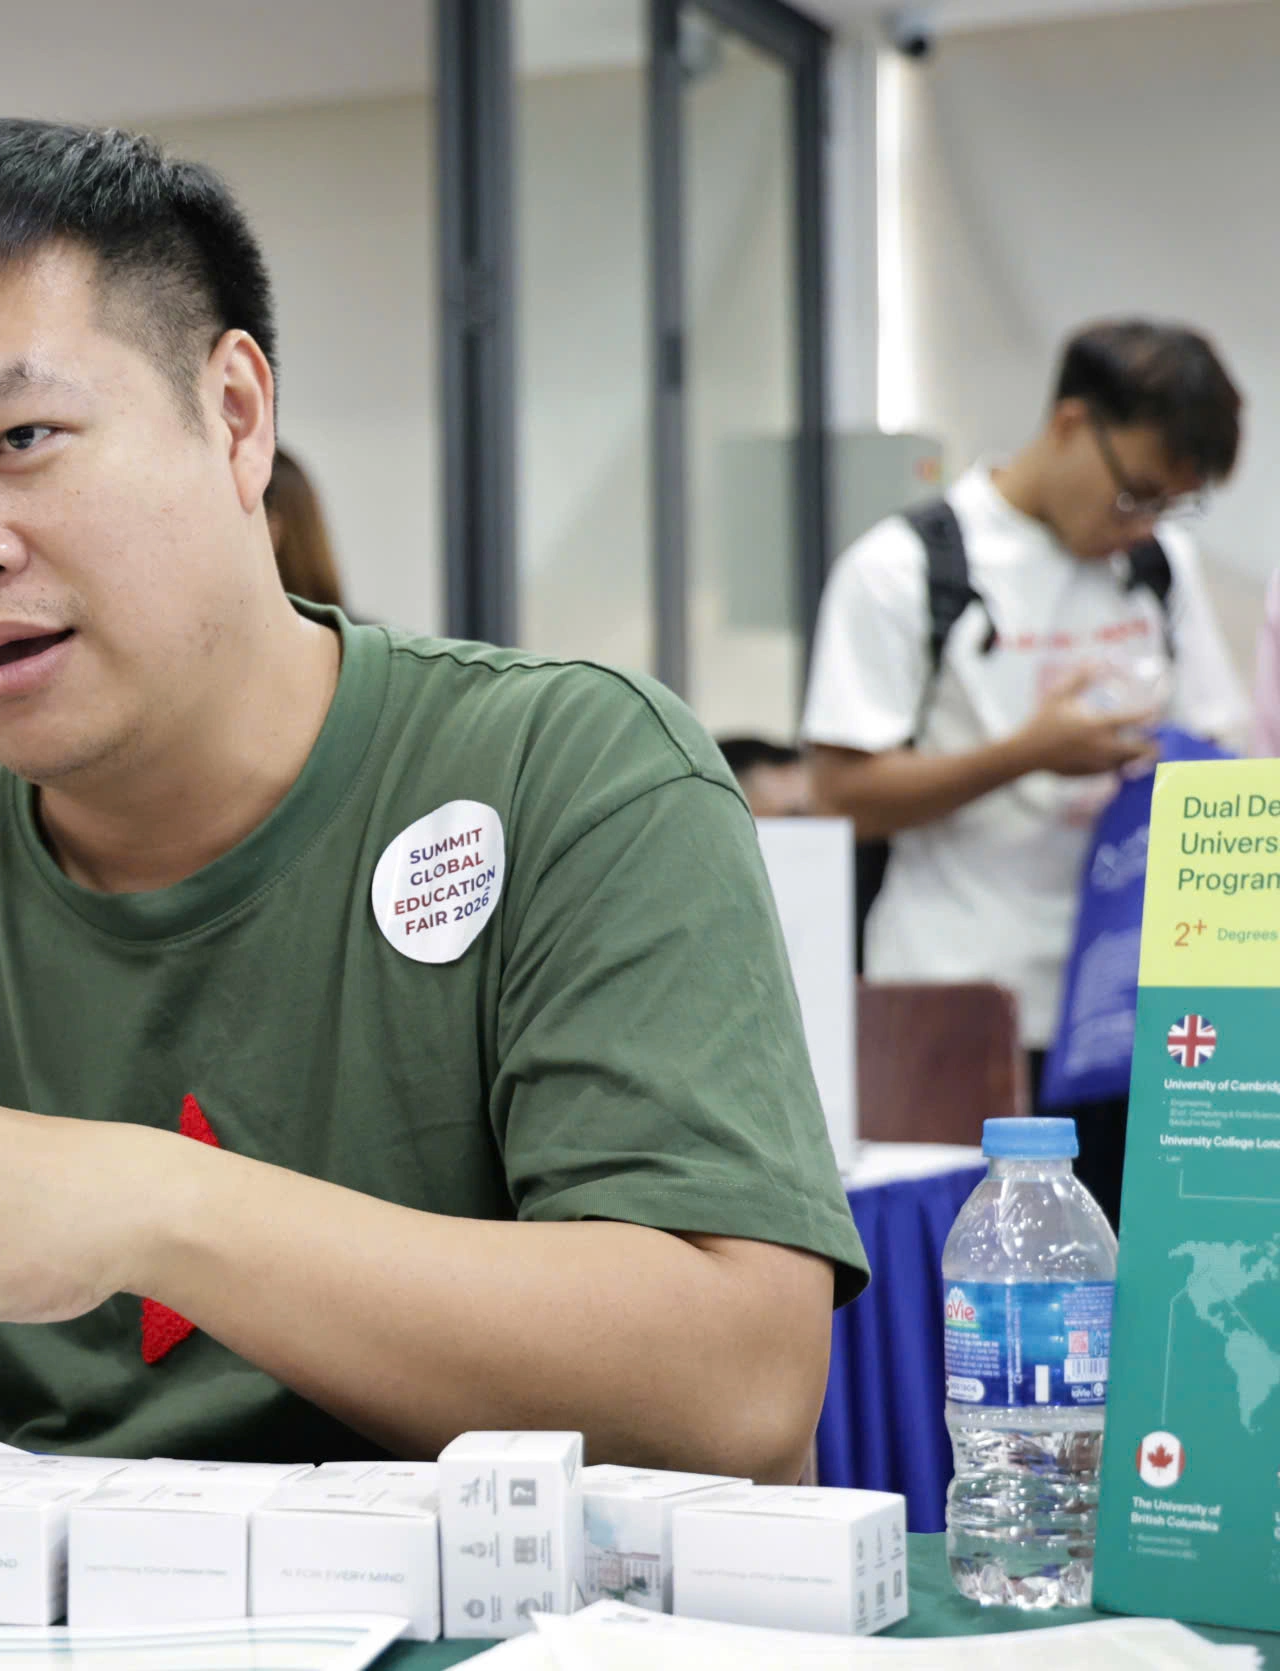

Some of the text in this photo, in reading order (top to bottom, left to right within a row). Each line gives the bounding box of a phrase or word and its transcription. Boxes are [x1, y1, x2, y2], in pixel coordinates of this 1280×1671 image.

[1183, 794, 1280, 818] Dual De
[410, 828, 482, 864] SUMMIT
[410, 852, 484, 886] GLOBAL
[394, 865, 495, 915] EDUCATION
[405, 887, 490, 935] FAIR 2026
[1217, 927, 1278, 944] Degrees
[1164, 1078, 1216, 1093] University
[1217, 1079, 1230, 1091] of
[1160, 1134, 1211, 1148] University
[1213, 1136, 1254, 1150] College
[1132, 1496, 1221, 1517] The University of
[1131, 1511, 1219, 1531] British Columbia
[367, 1572, 405, 1584] MIND
